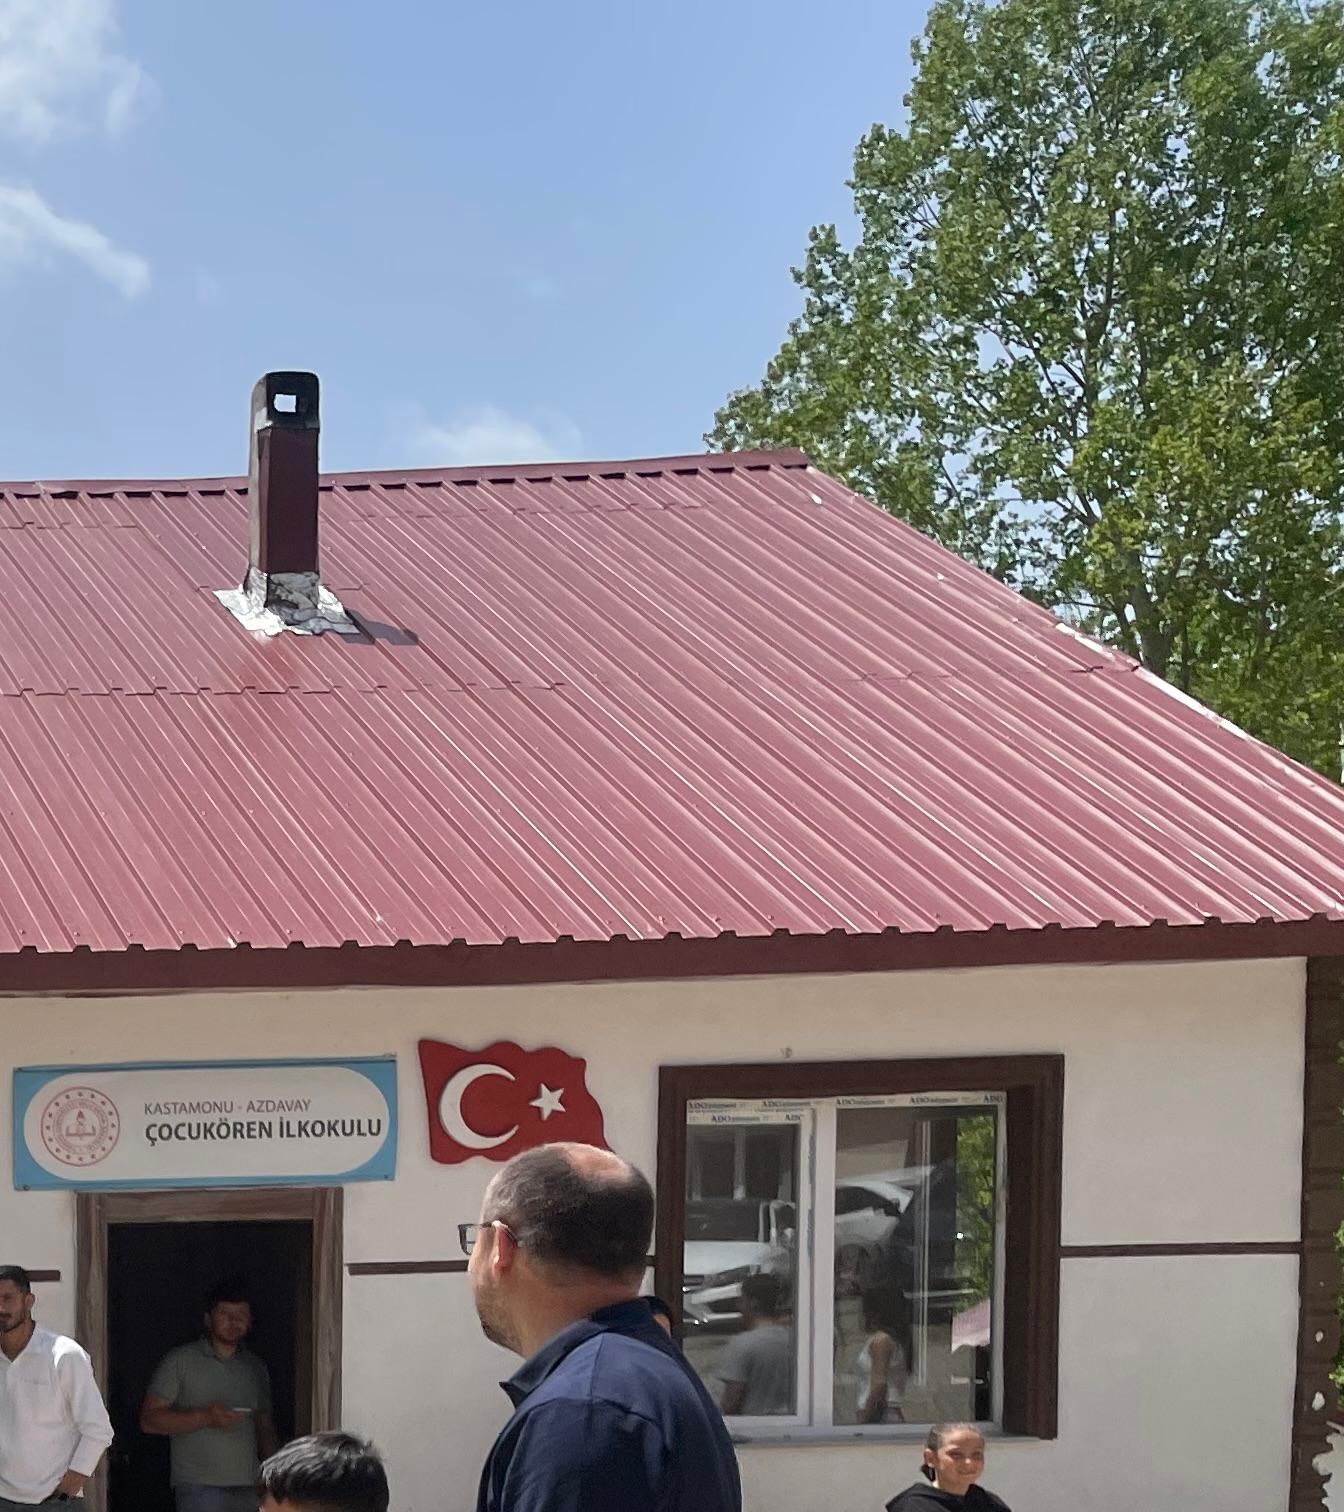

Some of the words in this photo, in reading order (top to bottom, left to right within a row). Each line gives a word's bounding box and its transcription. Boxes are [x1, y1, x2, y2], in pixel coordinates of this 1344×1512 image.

[144, 1100, 234, 1116] KASTAMONU
[246, 1099, 312, 1113] AZDAVAY
[145, 1117, 273, 1146] ÇOCUKÖREN
[278, 1116, 382, 1139] İLKOKULU
